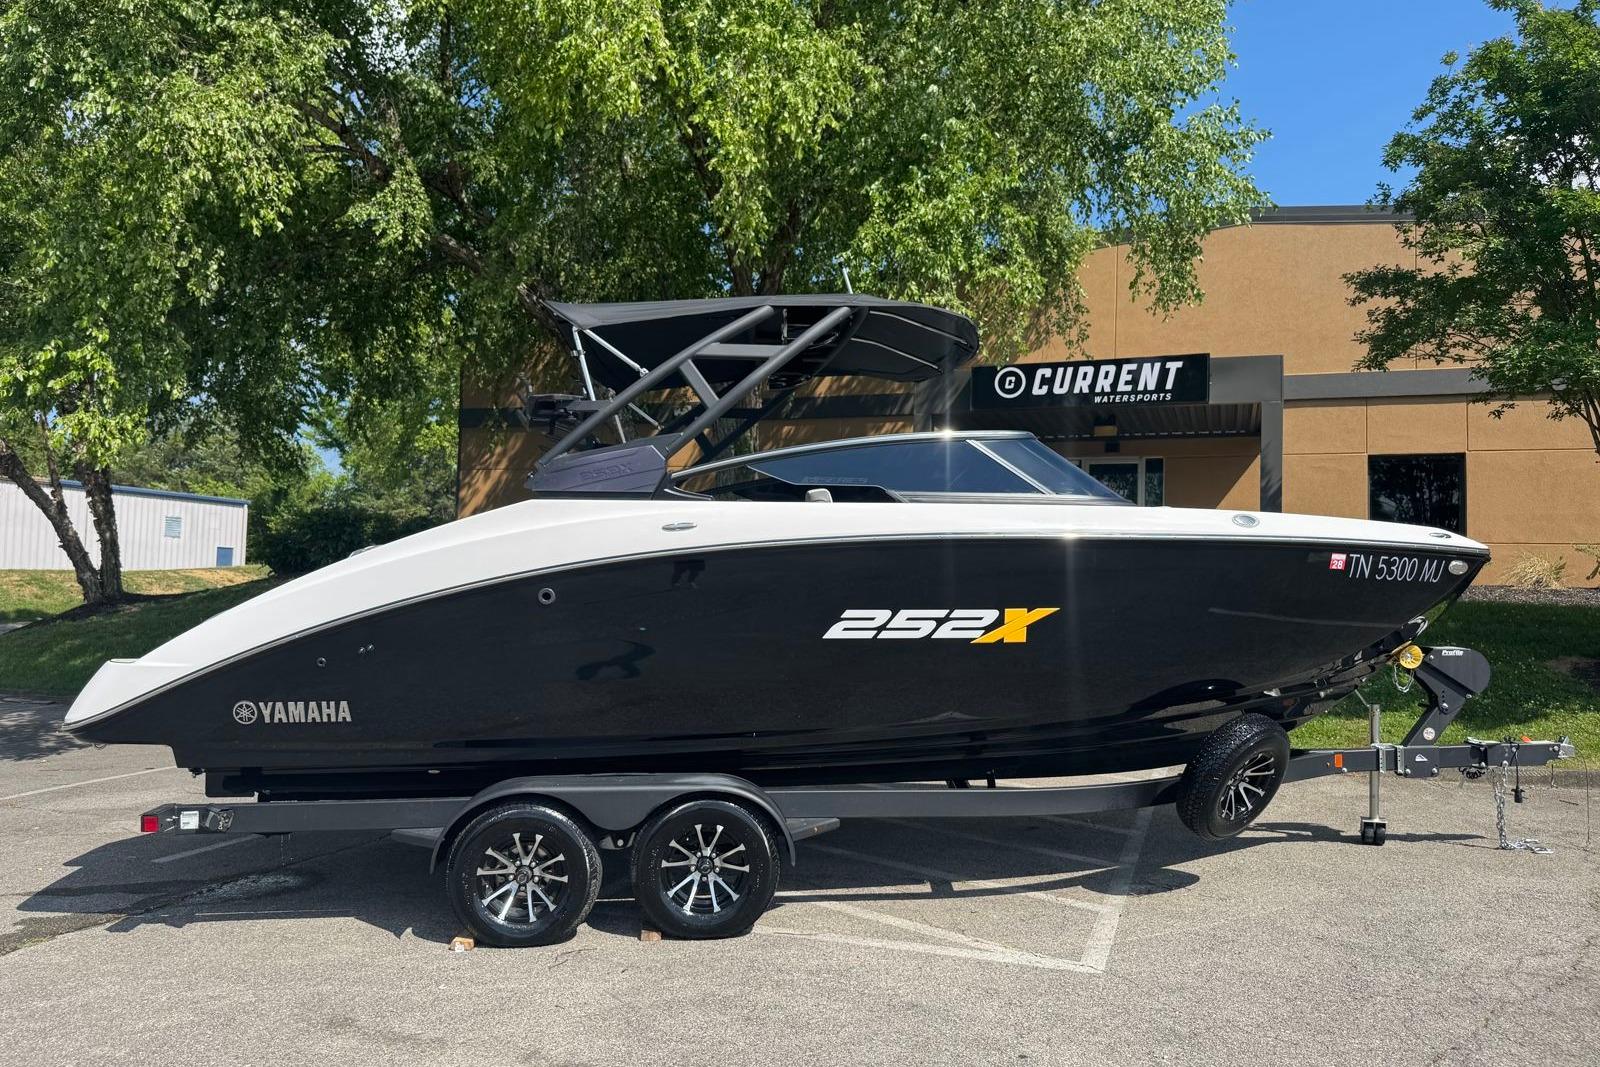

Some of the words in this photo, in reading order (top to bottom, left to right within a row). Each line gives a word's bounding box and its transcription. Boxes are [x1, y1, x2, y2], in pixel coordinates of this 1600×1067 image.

[1031, 361, 1184, 396] CURRENT
[1094, 392, 1173, 404] WATERSPORTS
[1331, 560, 1343, 569] 28
[1348, 554, 1373, 579] TN
[1375, 556, 1419, 582] 5300
[1418, 559, 1446, 583] MJ
[822, 607, 1060, 643] 252X
[258, 700, 352, 723] YAMAHA
